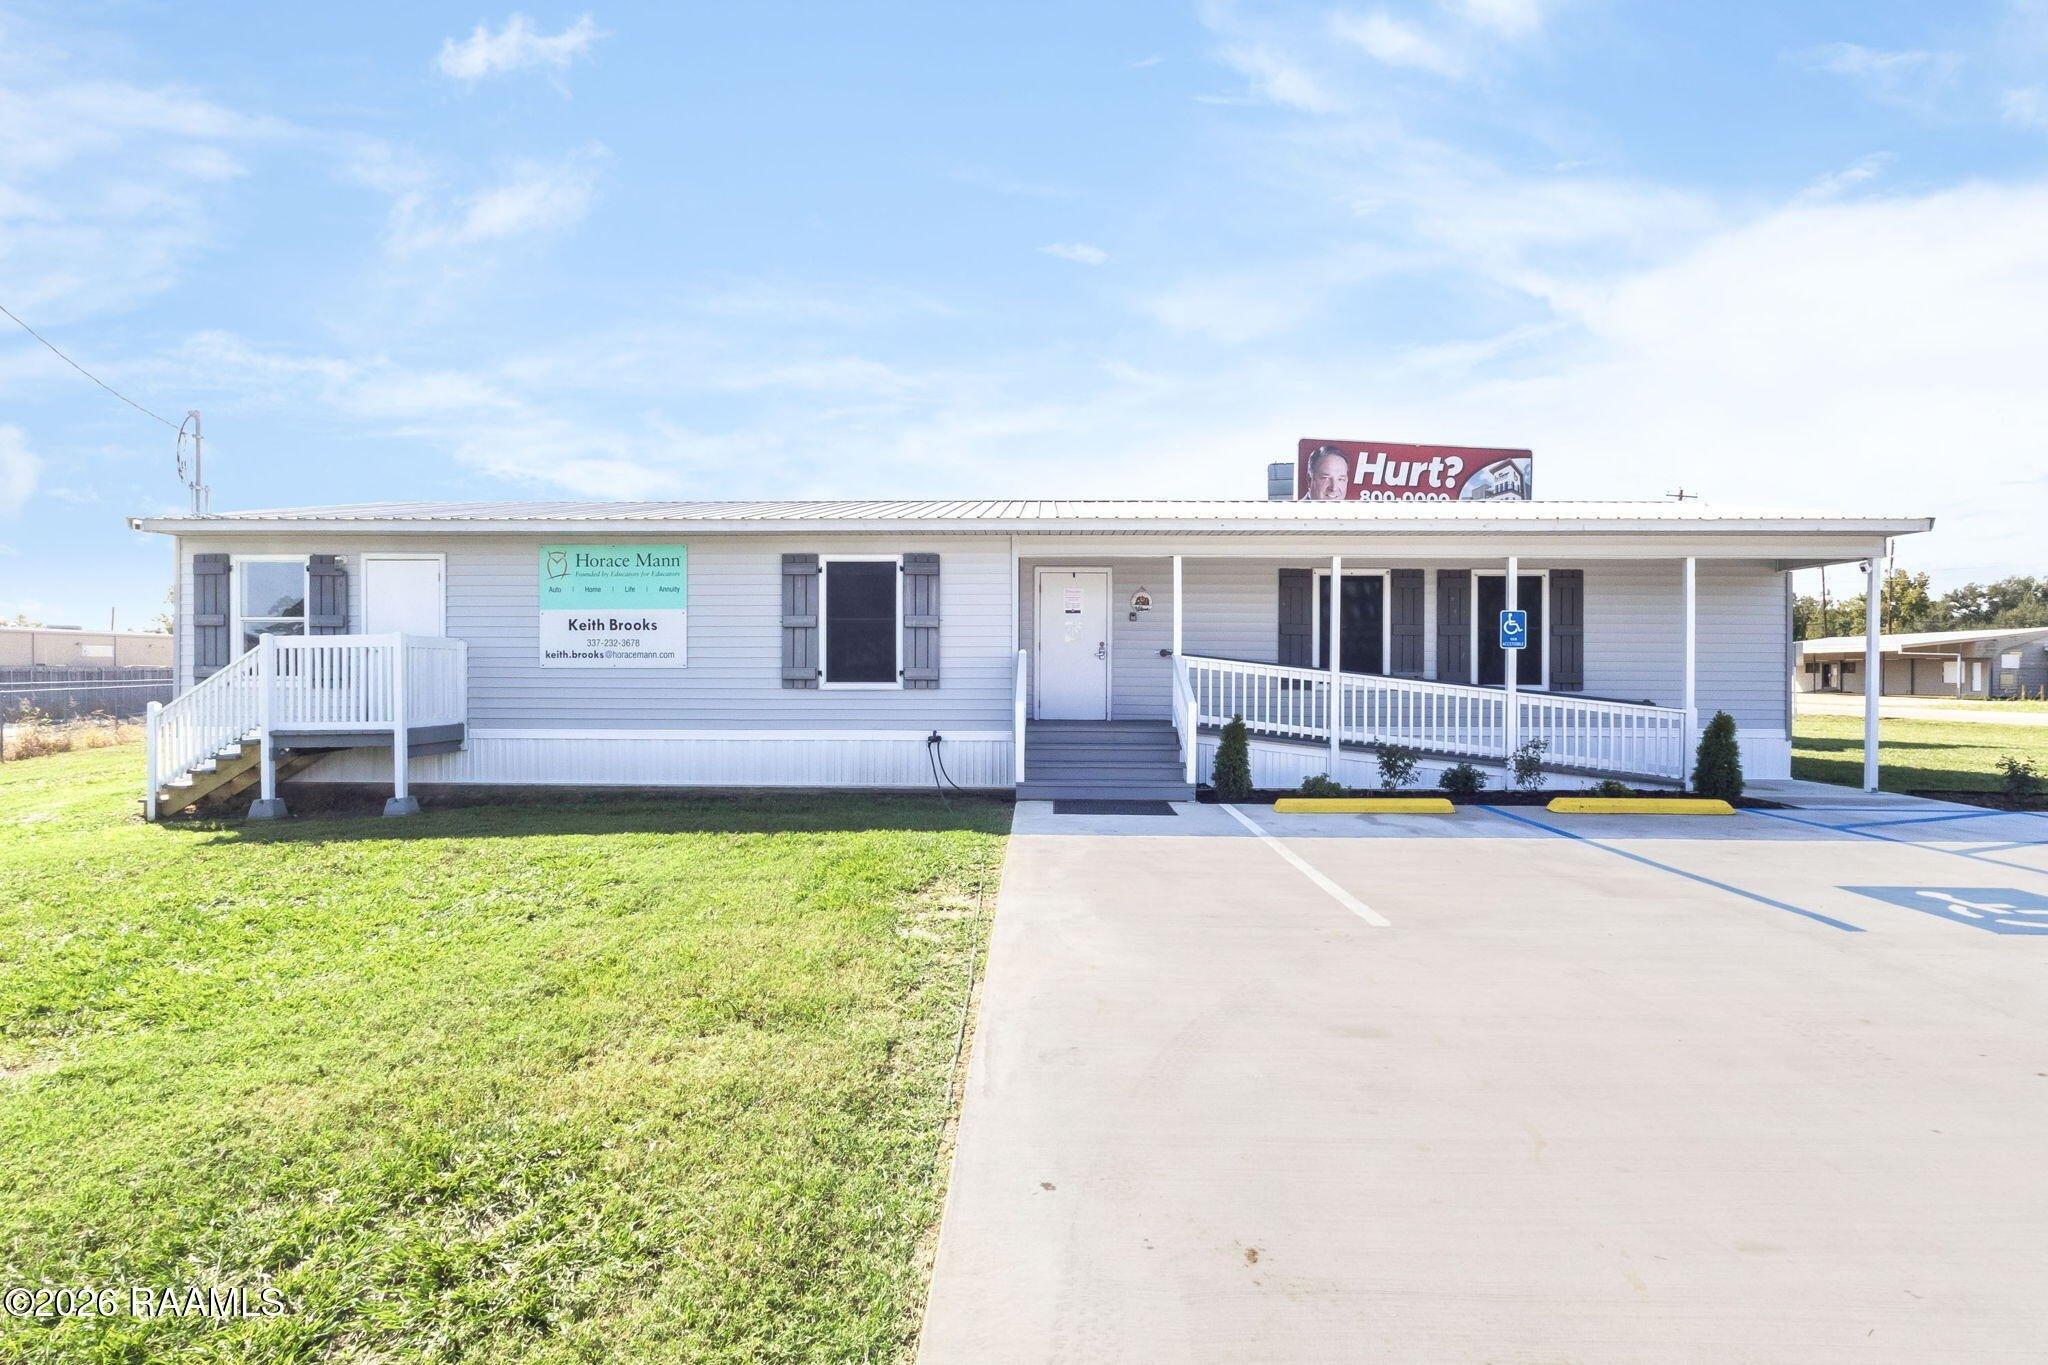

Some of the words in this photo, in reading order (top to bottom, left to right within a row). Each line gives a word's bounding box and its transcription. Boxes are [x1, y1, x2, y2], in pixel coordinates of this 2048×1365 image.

[1353, 451, 1464, 488] Hurt?
[575, 553, 630, 568] Horace
[636, 553, 680, 568] Mann
[602, 571, 609, 579] by
[640, 571, 650, 579] for
[658, 586, 680, 594] Annuity
[568, 618, 605, 631] Keith
[609, 618, 658, 631] Brooks
[586, 638, 640, 647] 337-232-3678
[545, 650, 675, 659] keith.brooks@horacemann.com
